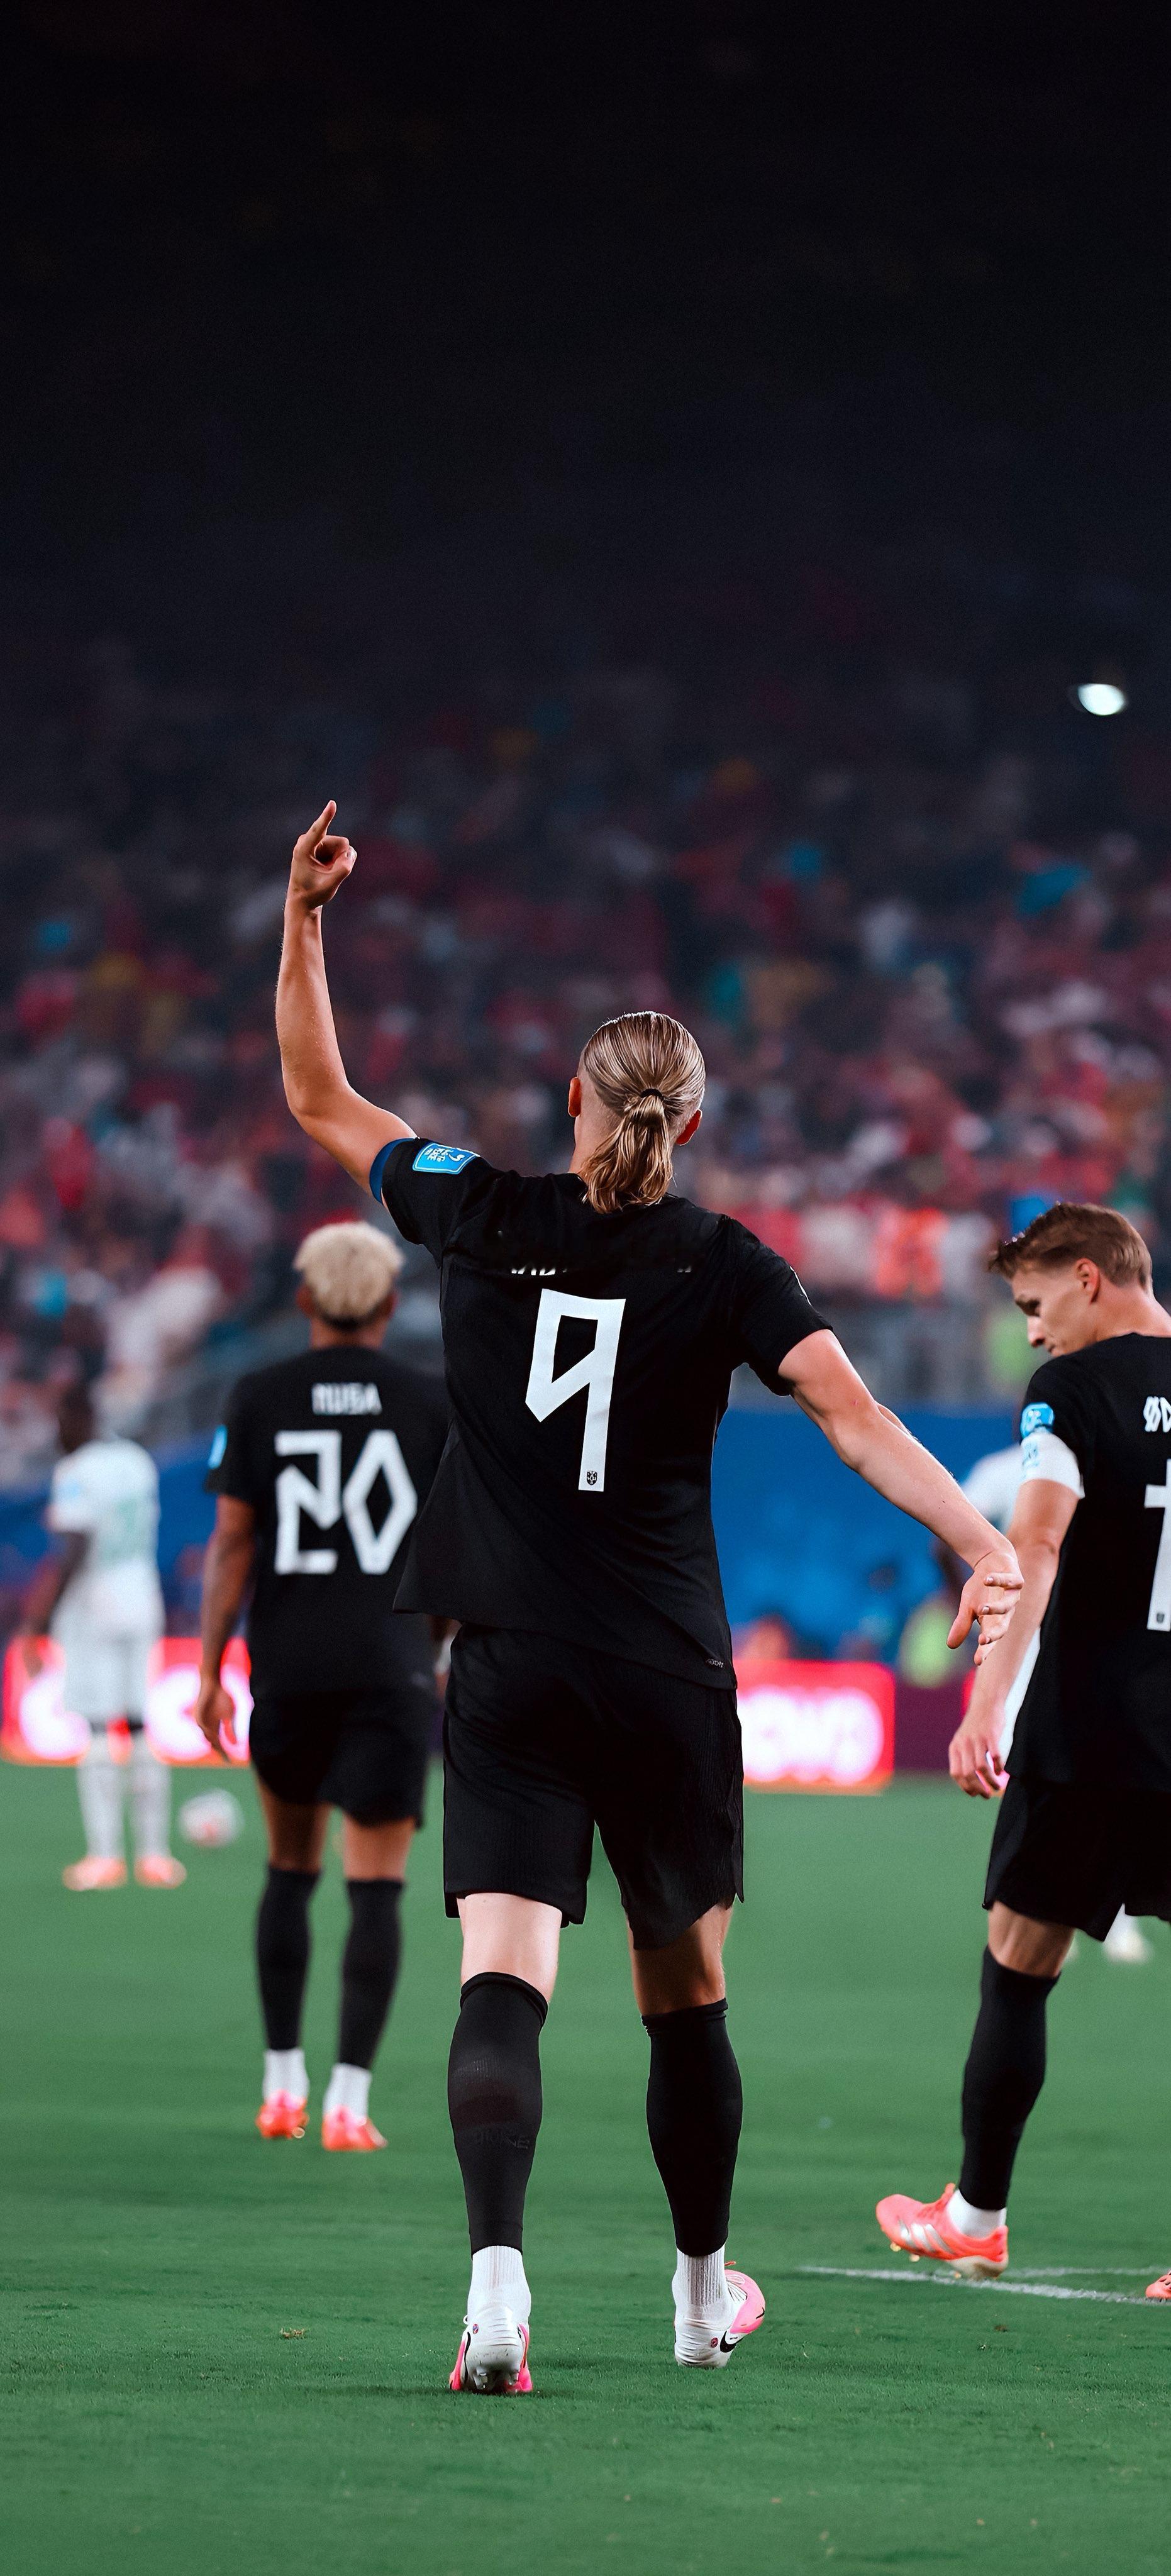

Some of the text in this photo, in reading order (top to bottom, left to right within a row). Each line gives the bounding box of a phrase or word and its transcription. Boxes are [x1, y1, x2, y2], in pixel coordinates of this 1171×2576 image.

[312, 1382, 382, 1415] NUSA
[525, 1288, 626, 1492] 9
[274, 1430, 418, 1575] 20
